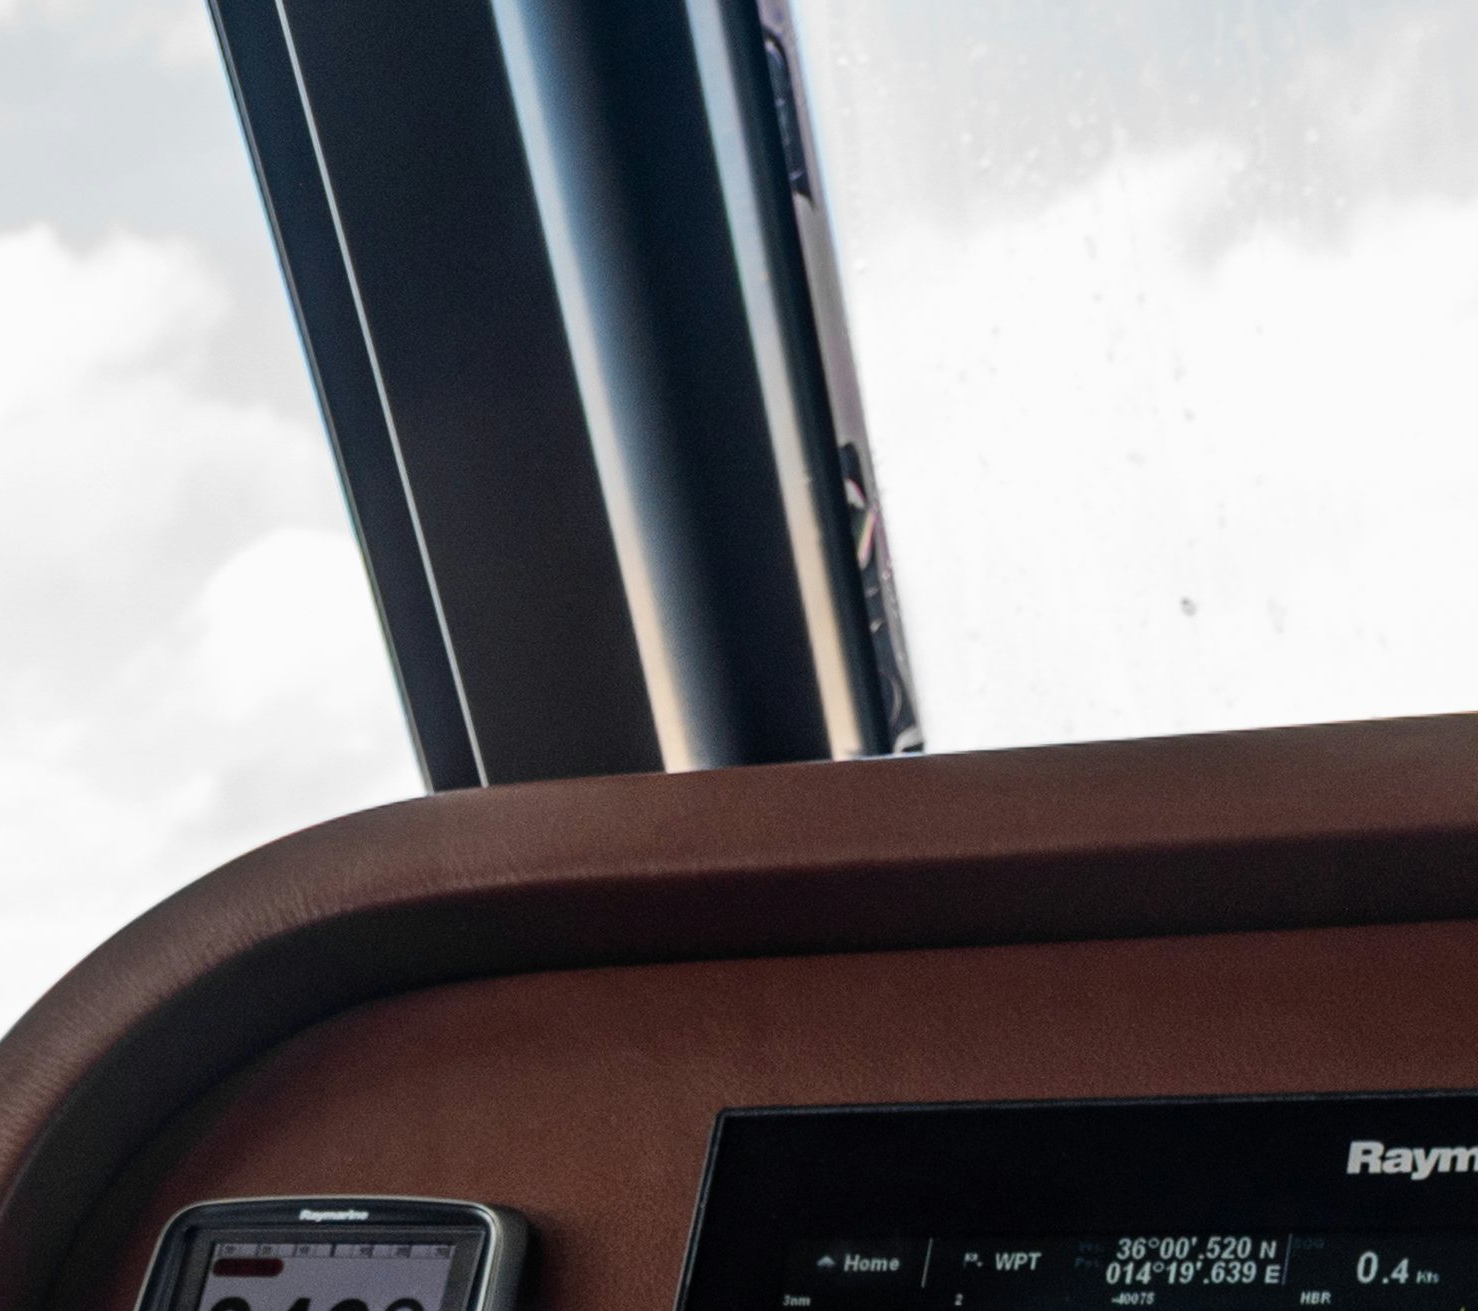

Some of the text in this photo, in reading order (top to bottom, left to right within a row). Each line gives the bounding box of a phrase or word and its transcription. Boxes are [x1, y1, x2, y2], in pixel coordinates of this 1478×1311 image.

[1259, 1240, 1277, 1260] N
[843, 1253, 900, 1272] Home
[995, 1252, 1042, 1271] WPT
[1356, 1250, 1409, 1284] 0.4
[1265, 1264, 1281, 1284] E
